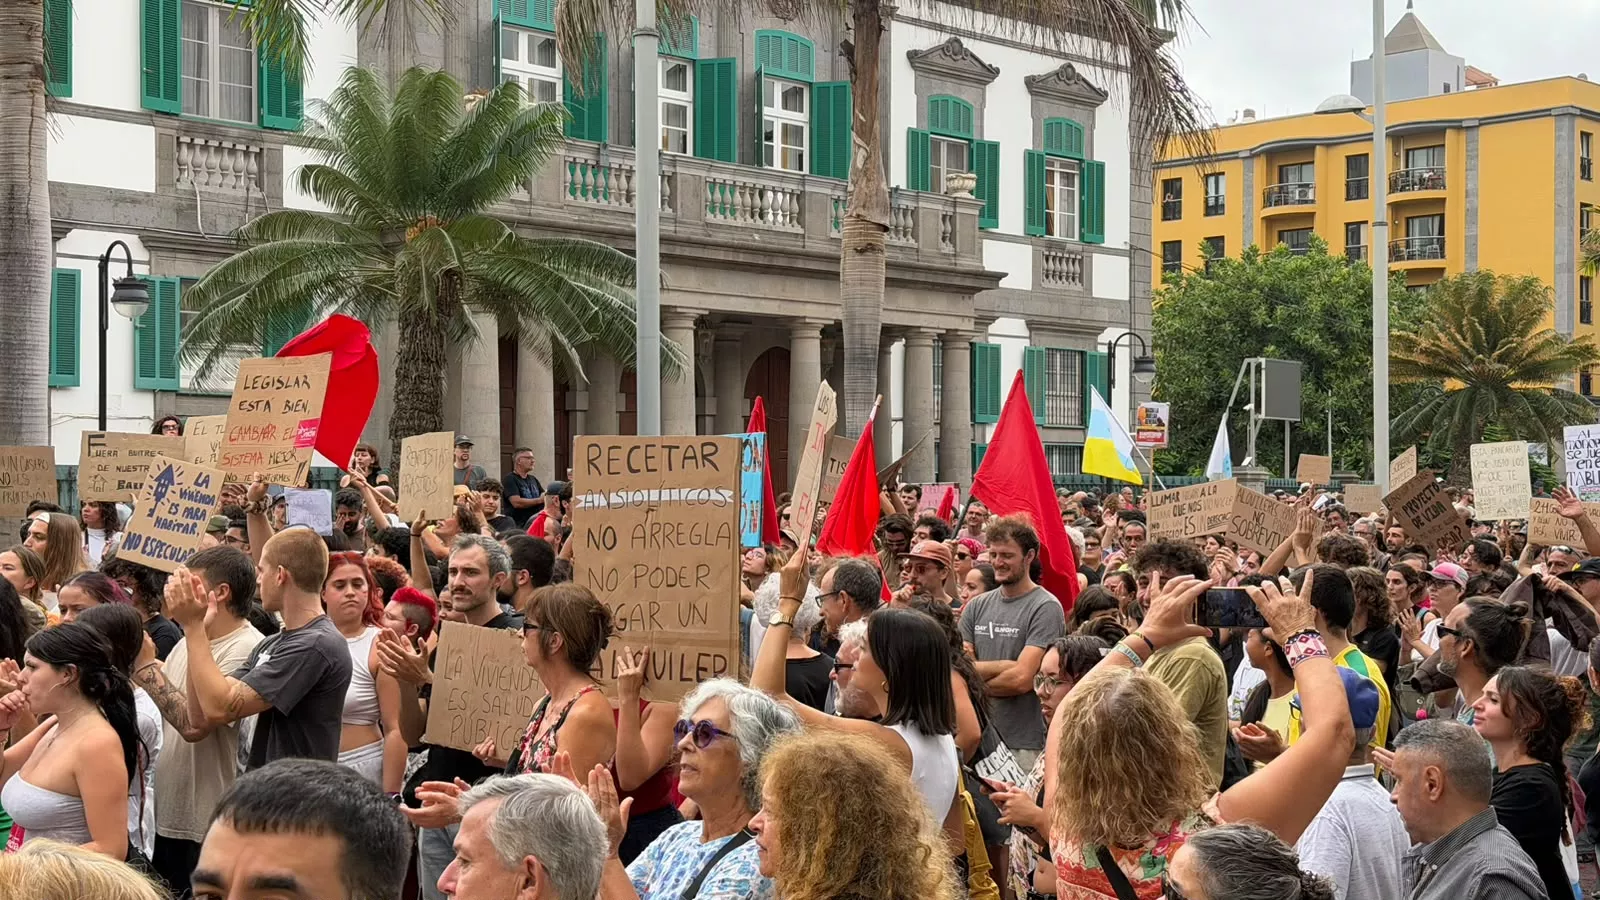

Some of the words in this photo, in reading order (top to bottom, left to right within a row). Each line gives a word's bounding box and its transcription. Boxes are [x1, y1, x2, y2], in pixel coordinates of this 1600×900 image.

[243, 374, 311, 391] LEGISLAR
[238, 397, 275, 413] ESTÁ
[281, 399, 311, 415] BIEN,
[193, 420, 207, 436] EL
[87, 434, 119, 457] FUERA
[222, 450, 264, 467] SISTEMA
[586, 441, 720, 476] RECETAR
[1512, 457, 1525, 467] LOS
[1576, 458, 1592, 470] en
[97, 464, 111, 472] DE
[115, 464, 150, 473] NUESTR
[224, 472, 238, 483] NO
[1507, 470, 1518, 481] TE
[193, 472, 211, 489] LA
[1151, 491, 1181, 507] LLAMAR
[1207, 485, 1217, 496] LA
[1401, 481, 1441, 519] PROYECTO
[168, 502, 180, 516] ES
[182, 506, 207, 521] PARA
[1172, 503, 1186, 517] QUE
[1187, 500, 1202, 513] NOS
[1252, 510, 1266, 525] NO
[1184, 515, 1196, 536] ES
[1410, 515, 1425, 530] DE
[121, 531, 143, 551] NO
[586, 525, 618, 551] NO
[630, 521, 733, 552] ARREGLA
[588, 566, 620, 592] NO
[633, 562, 712, 591] PODER
[614, 602, 665, 632] GAR
[677, 602, 709, 627] UN
[443, 651, 465, 681] LA
[447, 688, 468, 712] ES
[482, 694, 533, 718] SALUD
